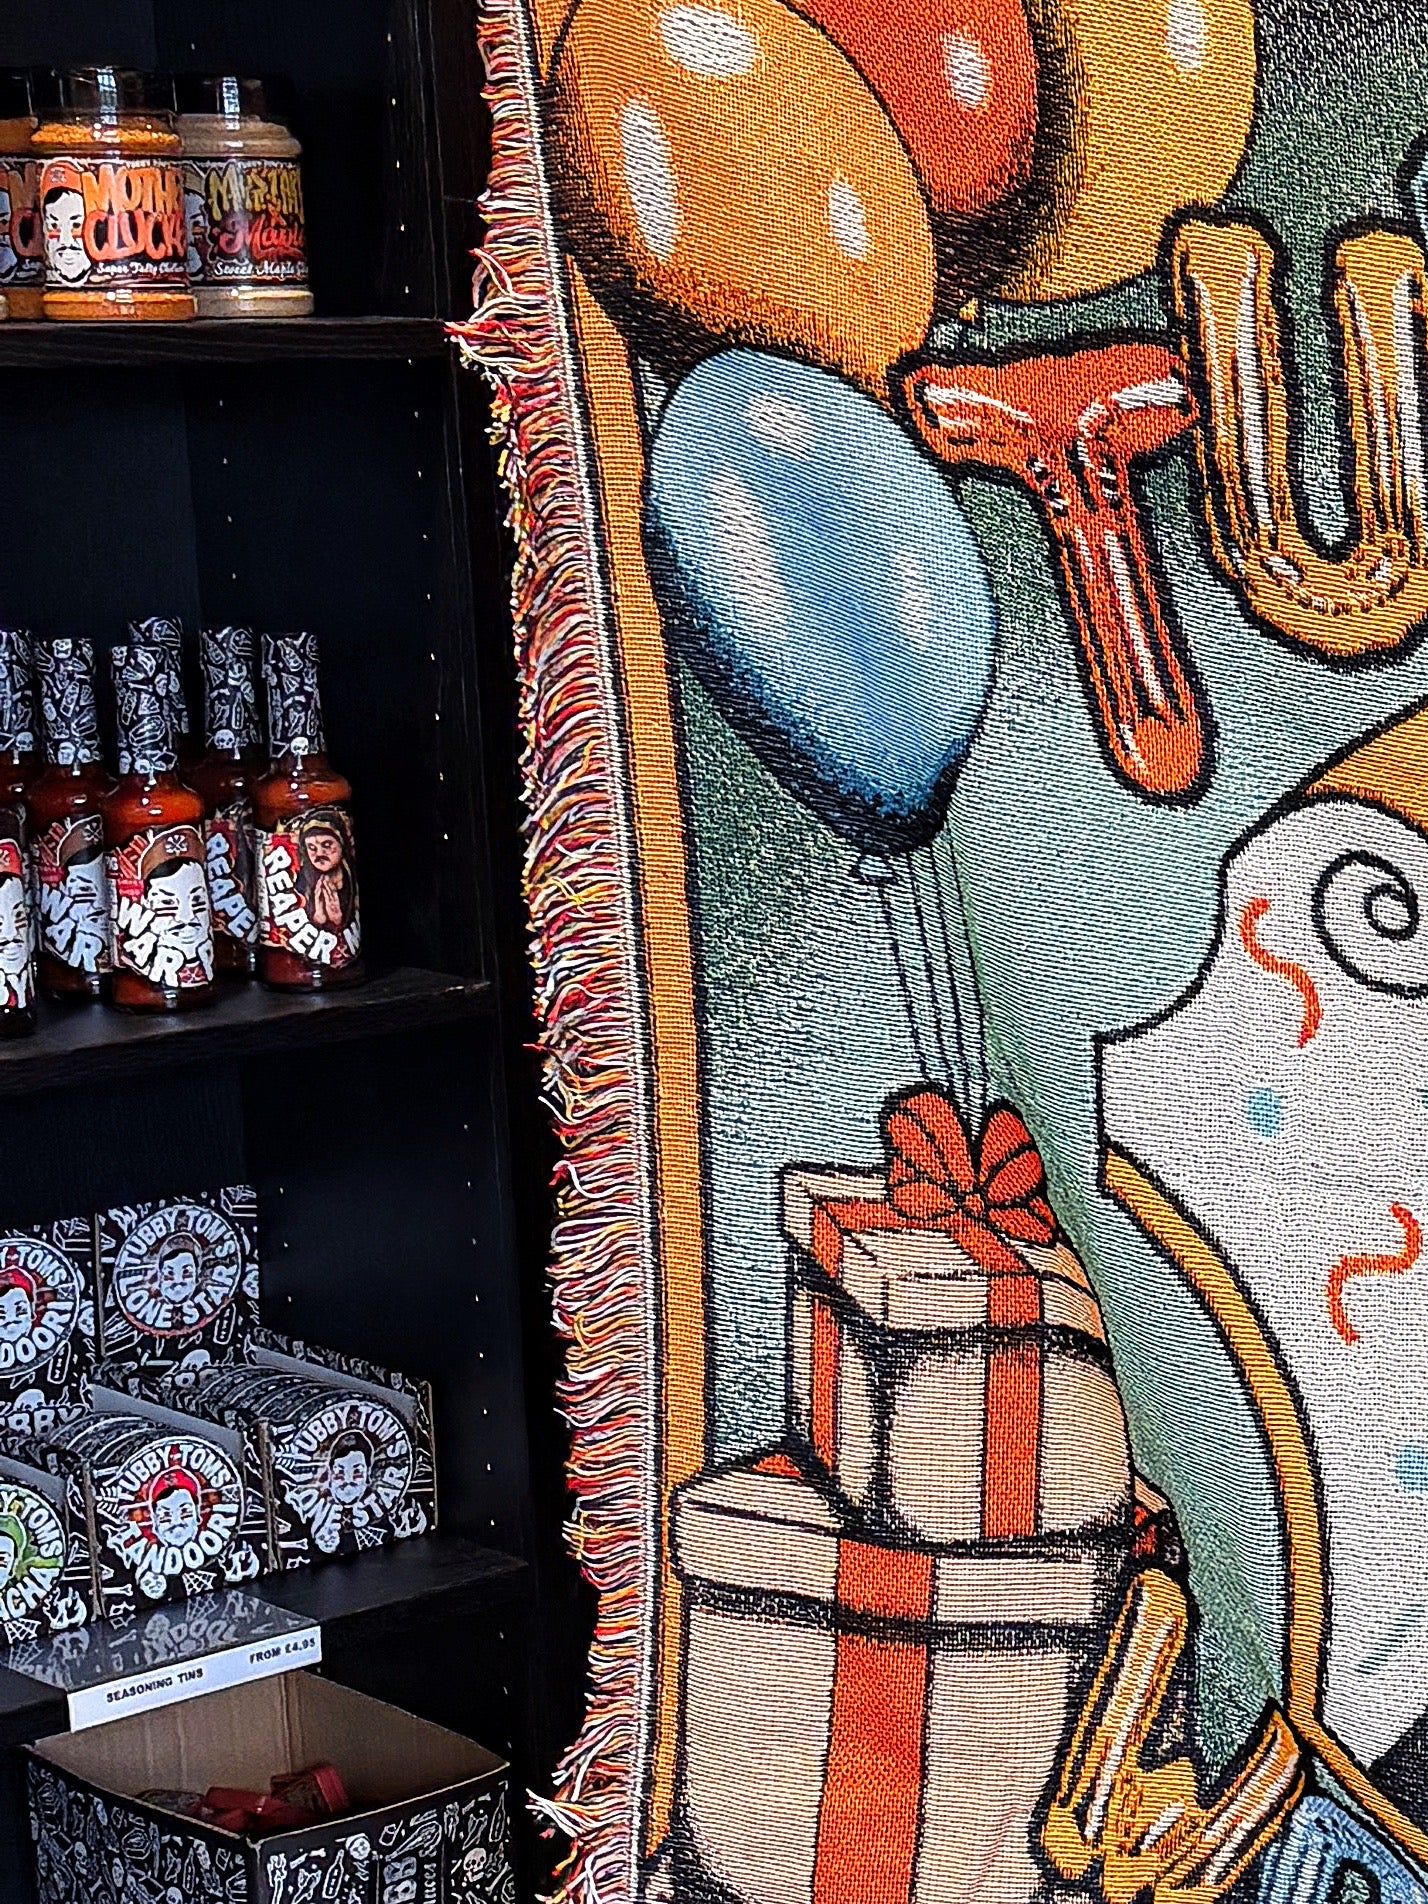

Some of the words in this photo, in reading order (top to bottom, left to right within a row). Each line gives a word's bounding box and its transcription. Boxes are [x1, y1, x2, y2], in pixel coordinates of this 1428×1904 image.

[206, 833, 258, 944] REAPE
[264, 845, 339, 964] REAPER
[40, 882, 103, 973] WAR
[118, 897, 186, 987] WAR
[121, 1208, 179, 1268] TUBBY
[185, 1211, 235, 1258] TOM'S
[119, 1275, 173, 1328] LONE
[182, 1264, 238, 1326] STAR
[298, 1406, 353, 1461] TUBBY
[356, 1404, 408, 1459] TOM'S
[119, 1447, 172, 1500] TUBBY
[352, 1464, 408, 1529] STAR
[124, 1503, 239, 1575] TANDOORI
[106, 1677, 173, 1704] SEASONING
[176, 1667, 204, 1685] TINS
[249, 1648, 282, 1665] FROM
[285, 1638, 316, 1658] £4.95
